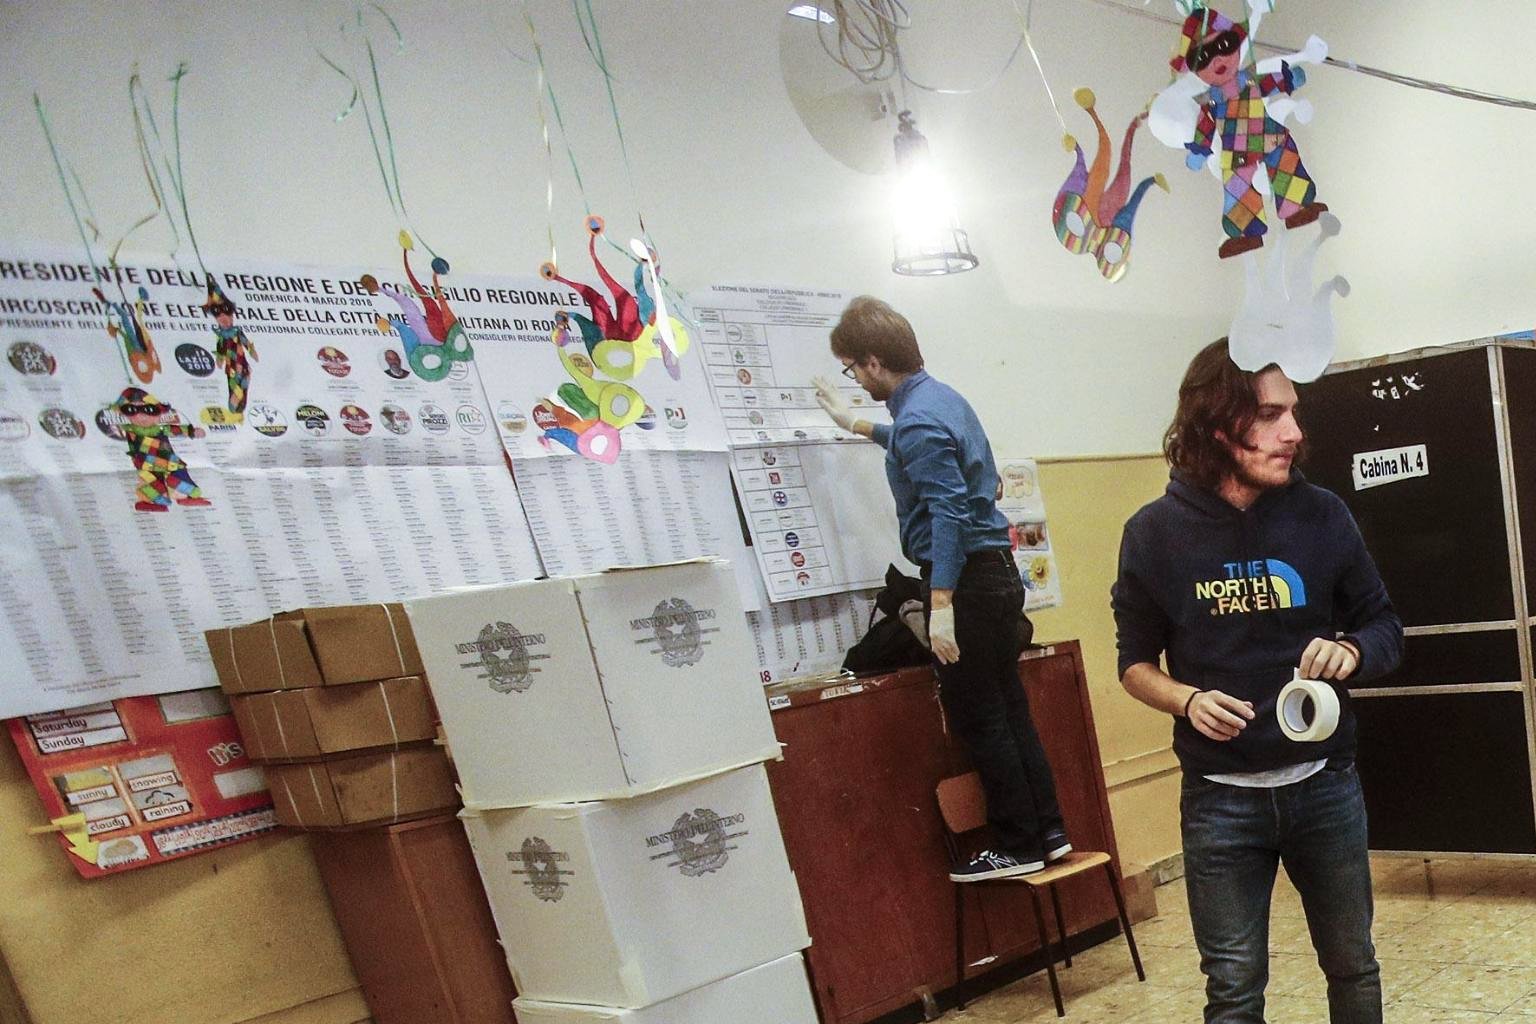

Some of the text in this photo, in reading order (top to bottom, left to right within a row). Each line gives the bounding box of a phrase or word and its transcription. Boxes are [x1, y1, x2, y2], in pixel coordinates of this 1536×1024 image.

[224, 273, 318, 294] REGIONE
[321, 279, 336, 295] E
[486, 287, 579, 307] REGIONALE
[244, 292, 373, 307] DOMENICA 4 MARZO 2018
[0, 298, 161, 318] IRCOSCRIONE
[166, 303, 280, 321] ELETRALE
[283, 308, 337, 323] DELLA
[514, 319, 529, 331] DI
[308, 326, 360, 336] COLLEGATE
[1359, 450, 1424, 480] Cabina N. 4
[1223, 560, 1264, 579] THE
[1195, 576, 1269, 600] NORTH
[1217, 593, 1270, 616] FACE
[34, 718, 88, 733] Saturday
[42, 735, 85, 750] Sunday
[132, 773, 174, 789] snowing
[77, 788, 109, 801] sunny
[149, 803, 186, 818] raining
[89, 817, 126, 832] cloudy
